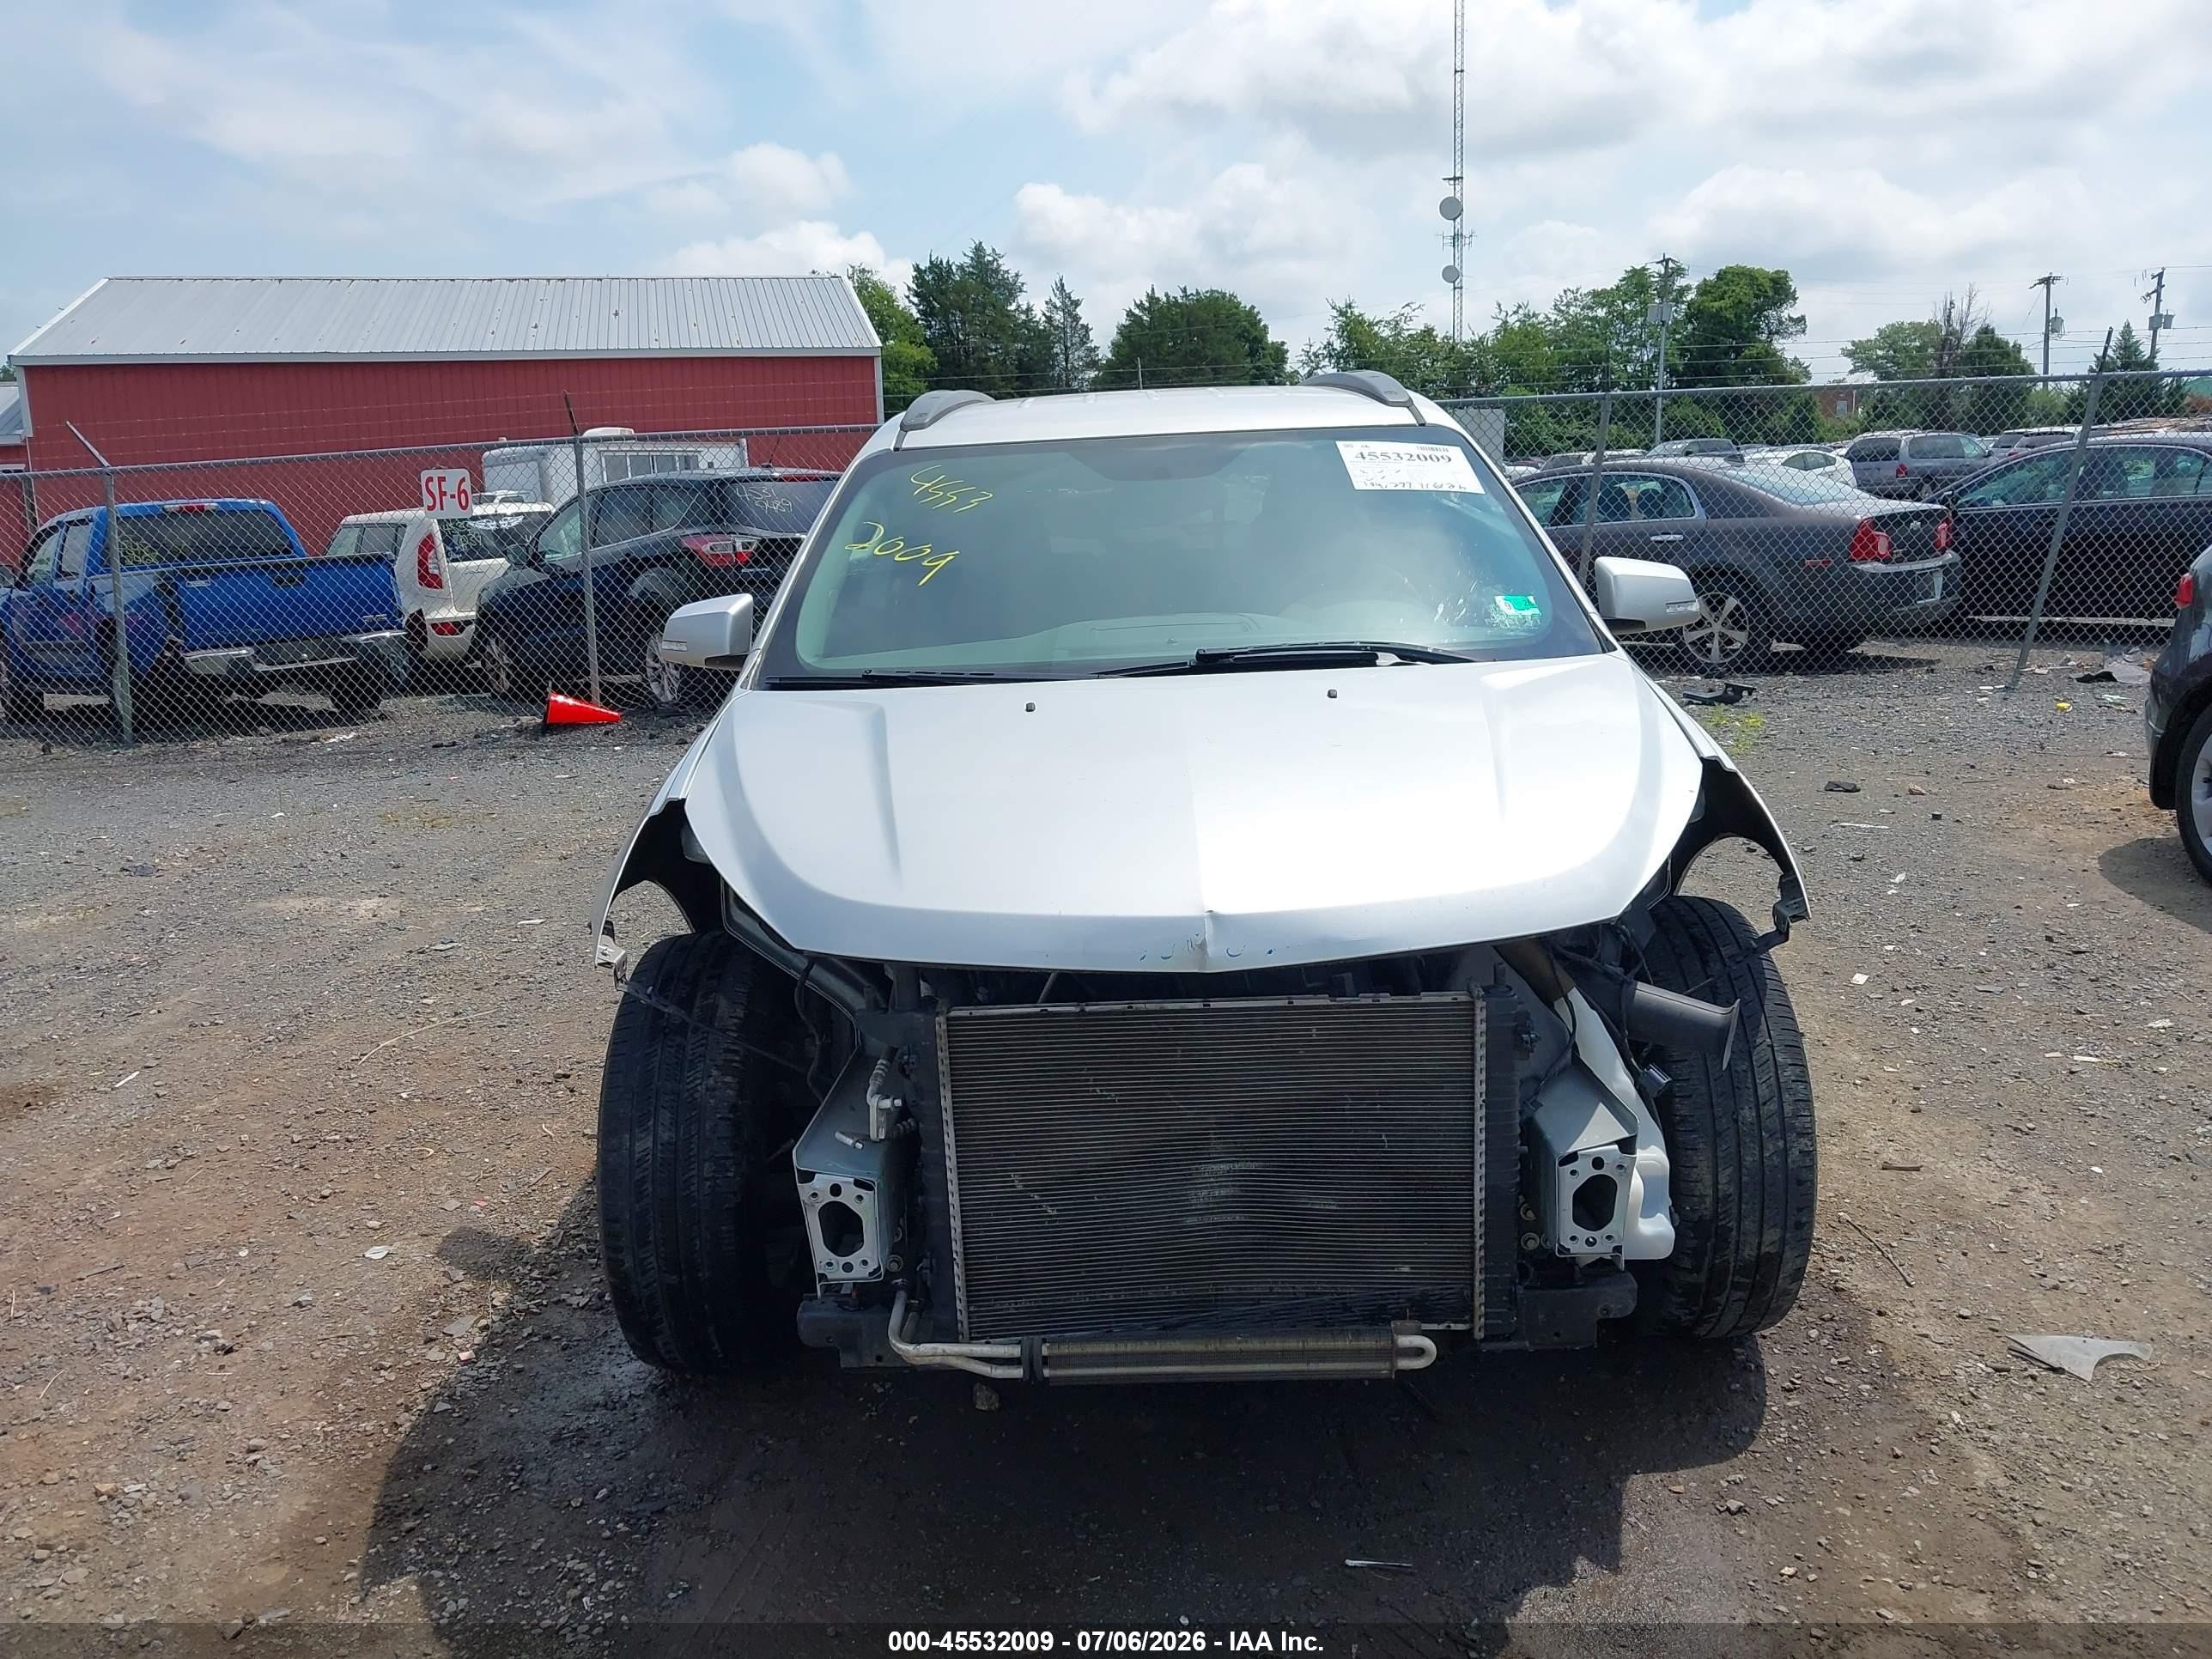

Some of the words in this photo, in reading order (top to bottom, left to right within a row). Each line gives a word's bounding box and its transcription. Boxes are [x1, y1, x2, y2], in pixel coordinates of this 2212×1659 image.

[1354, 451, 1453, 464] 45532009
[425, 476, 469, 512] SF-6
[910, 465, 994, 514] 4553
[844, 521, 961, 586] 2009
